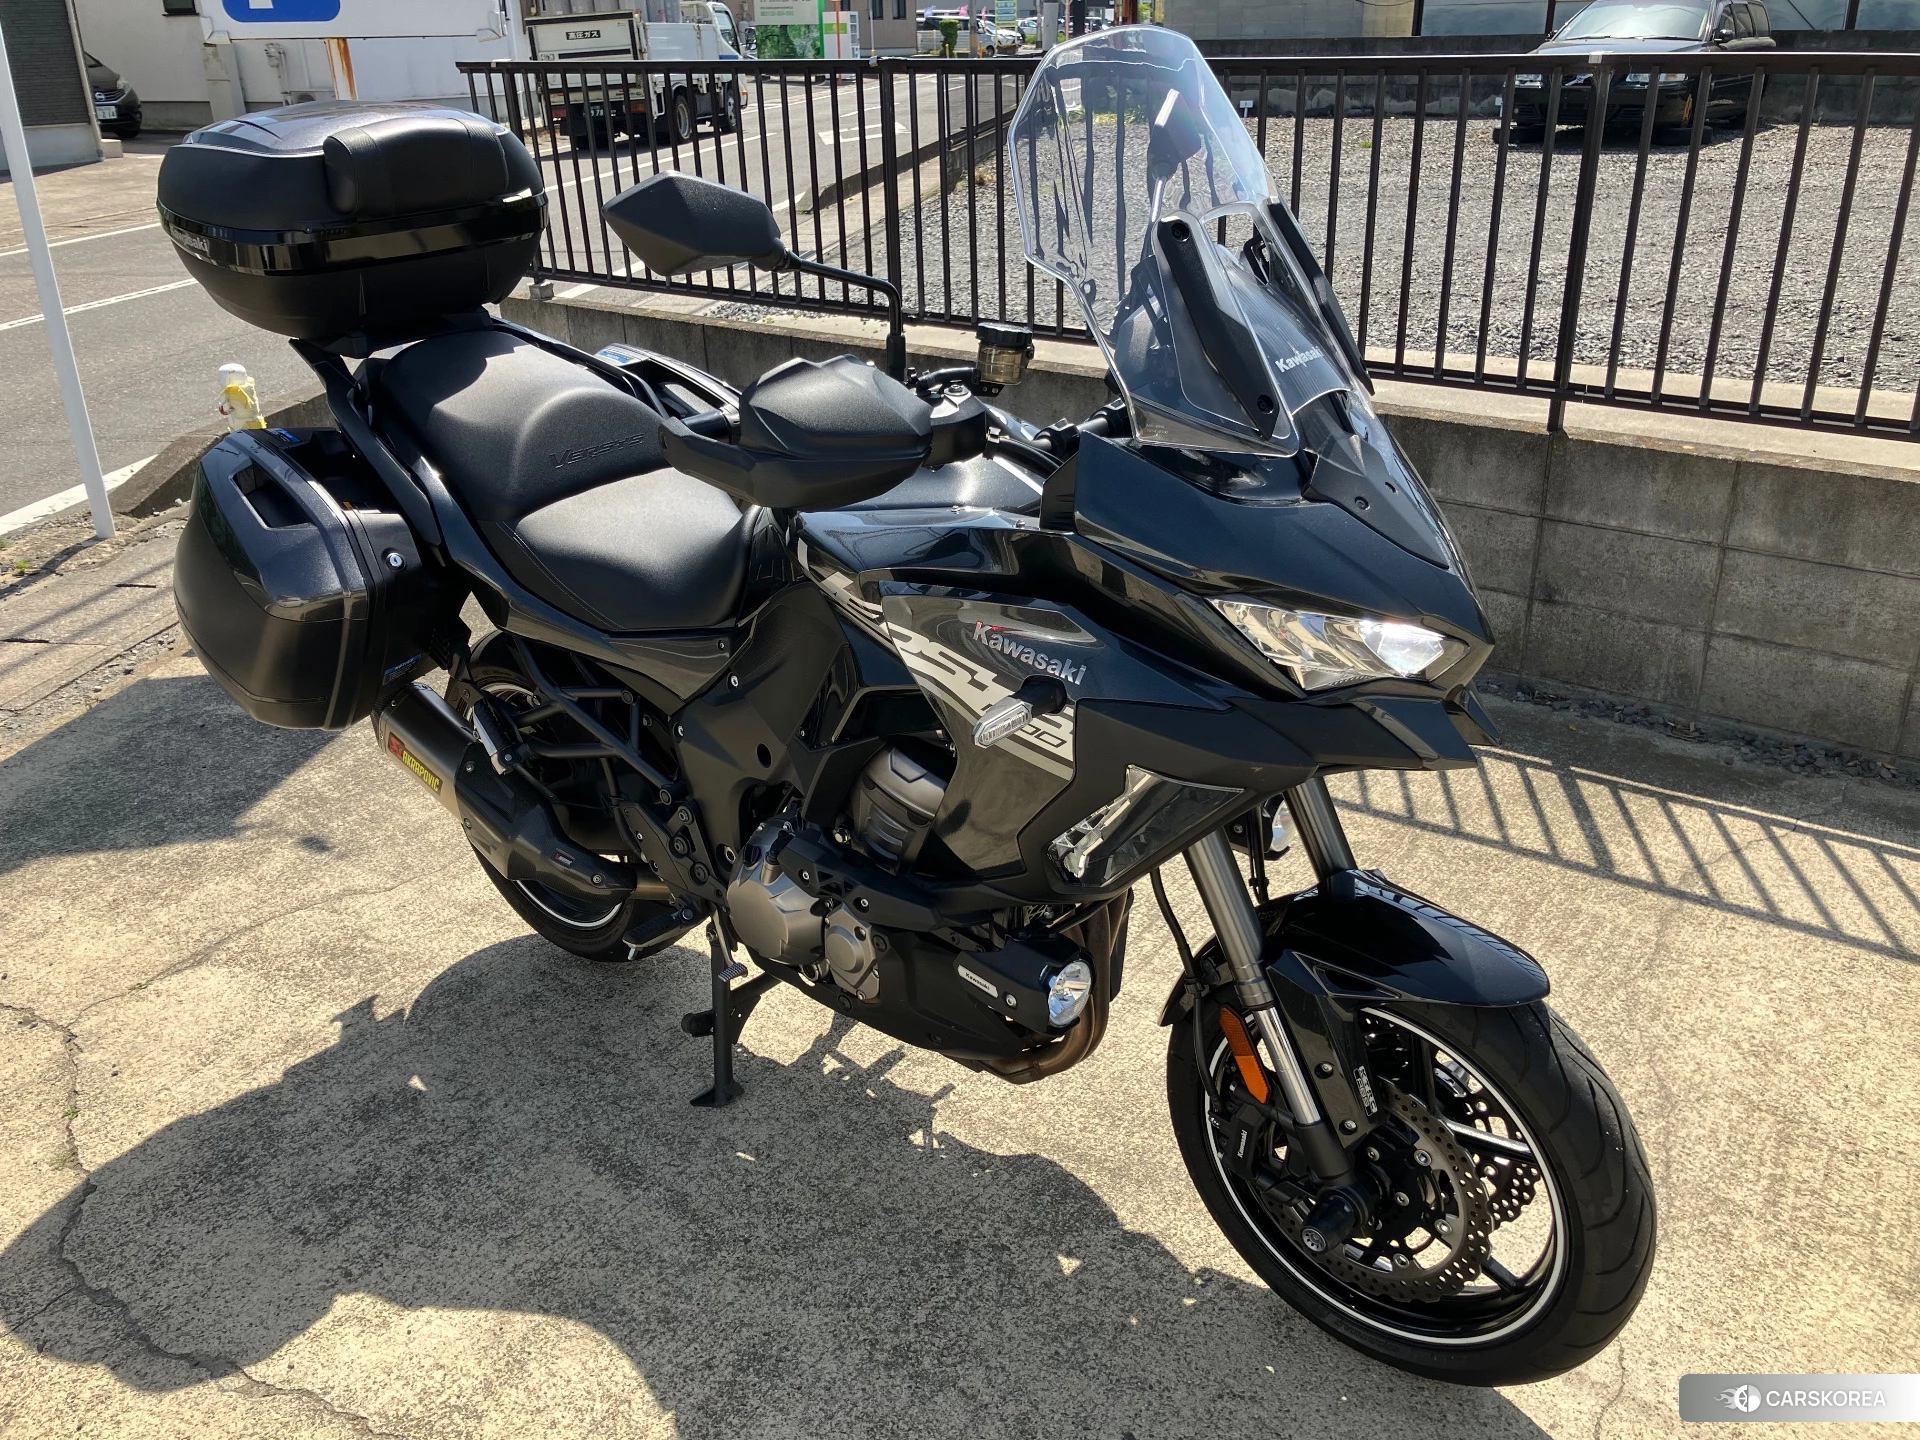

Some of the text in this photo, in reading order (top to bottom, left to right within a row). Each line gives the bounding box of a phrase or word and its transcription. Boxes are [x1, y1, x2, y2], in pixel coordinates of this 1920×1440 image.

[568, 31, 599, 40] 高圧ガス
[1275, 345, 1324, 373] Kawasaki
[973, 620, 1087, 686] Kawasaki
[965, 972, 990, 991] Kawasaki
